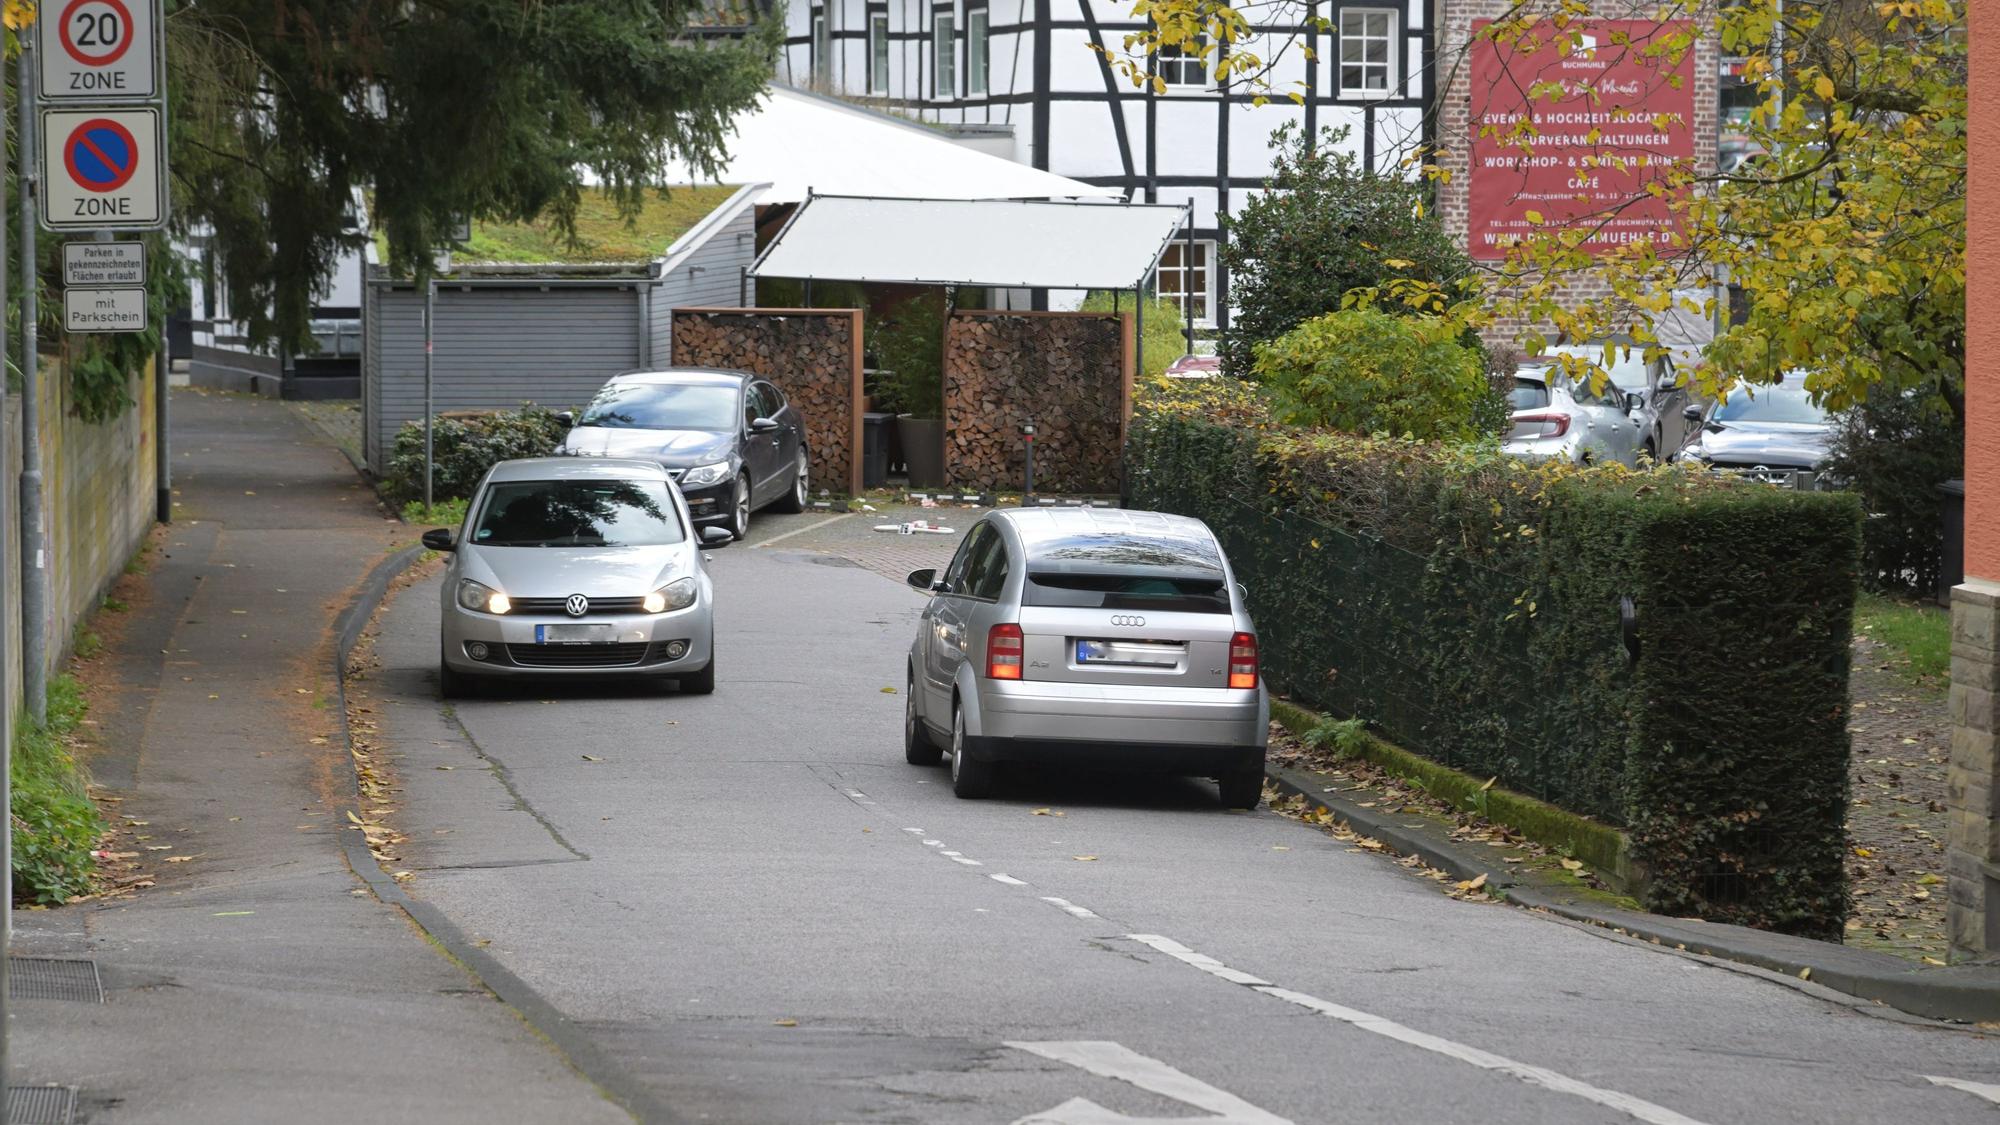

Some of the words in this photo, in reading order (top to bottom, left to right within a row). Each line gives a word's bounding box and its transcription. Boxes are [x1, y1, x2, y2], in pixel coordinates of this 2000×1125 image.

[76, 13, 118, 46] 20
[70, 72, 126, 89] ZONE
[1534, 113, 1542, 124] &
[1547, 112, 1682, 124] HOCHZEITSLOCATN
[1497, 134, 1669, 145] ULURVERANTALTUNGEN
[1568, 156, 1576, 168] &
[1581, 154, 1680, 168] SMIARÄUM
[1567, 176, 1599, 189] CAFÉ
[74, 198, 131, 216] ZONE
[84, 247, 112, 257] Parken
[116, 247, 124, 257] in
[68, 259, 141, 271] gekennzeichneten
[72, 271, 104, 281] Flächen
[107, 271, 137, 281] erlaubt
[95, 299, 116, 308] mit
[72, 311, 139, 322] Parkschein
